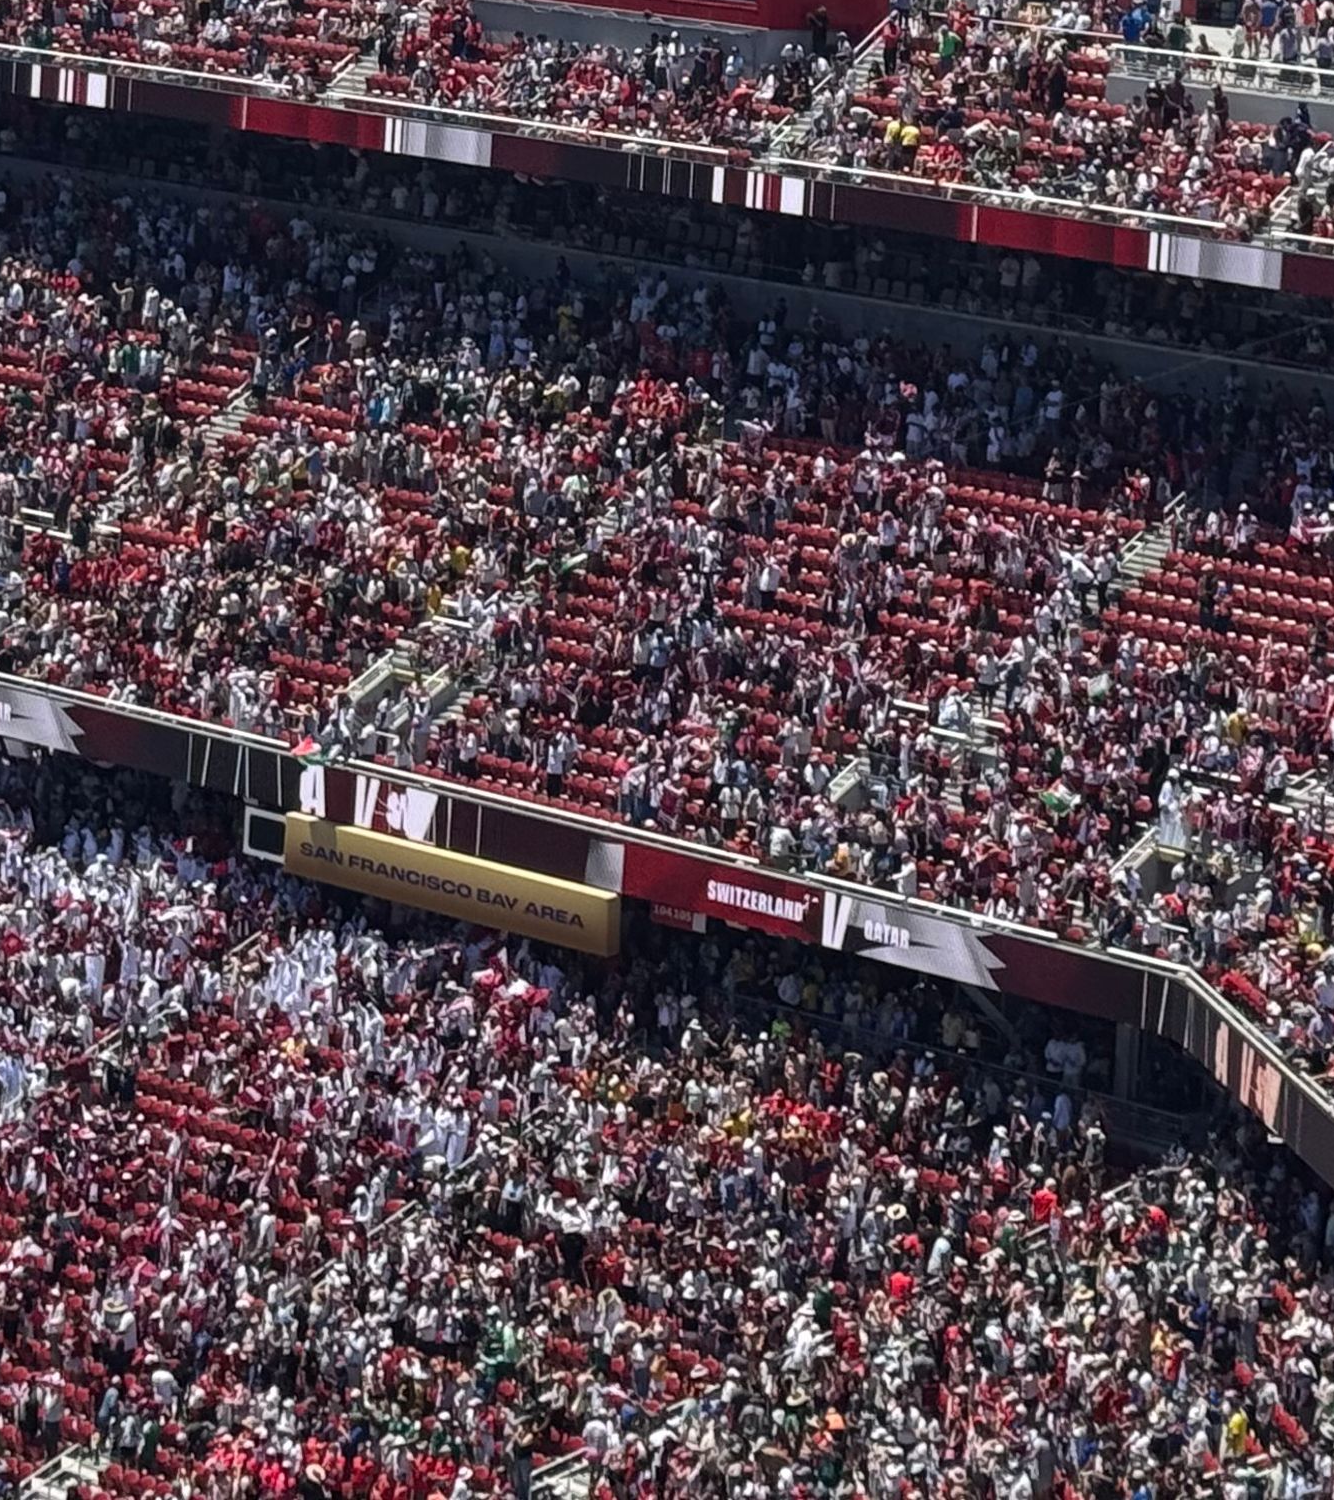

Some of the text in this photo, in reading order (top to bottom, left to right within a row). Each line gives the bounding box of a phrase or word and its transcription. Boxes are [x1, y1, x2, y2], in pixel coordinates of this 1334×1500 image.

[299, 841, 585, 929] SAN FRANCISCO BAY AREA
[707, 879, 804, 922] SWITZERLAND
[864, 918, 911, 948] QATAR
